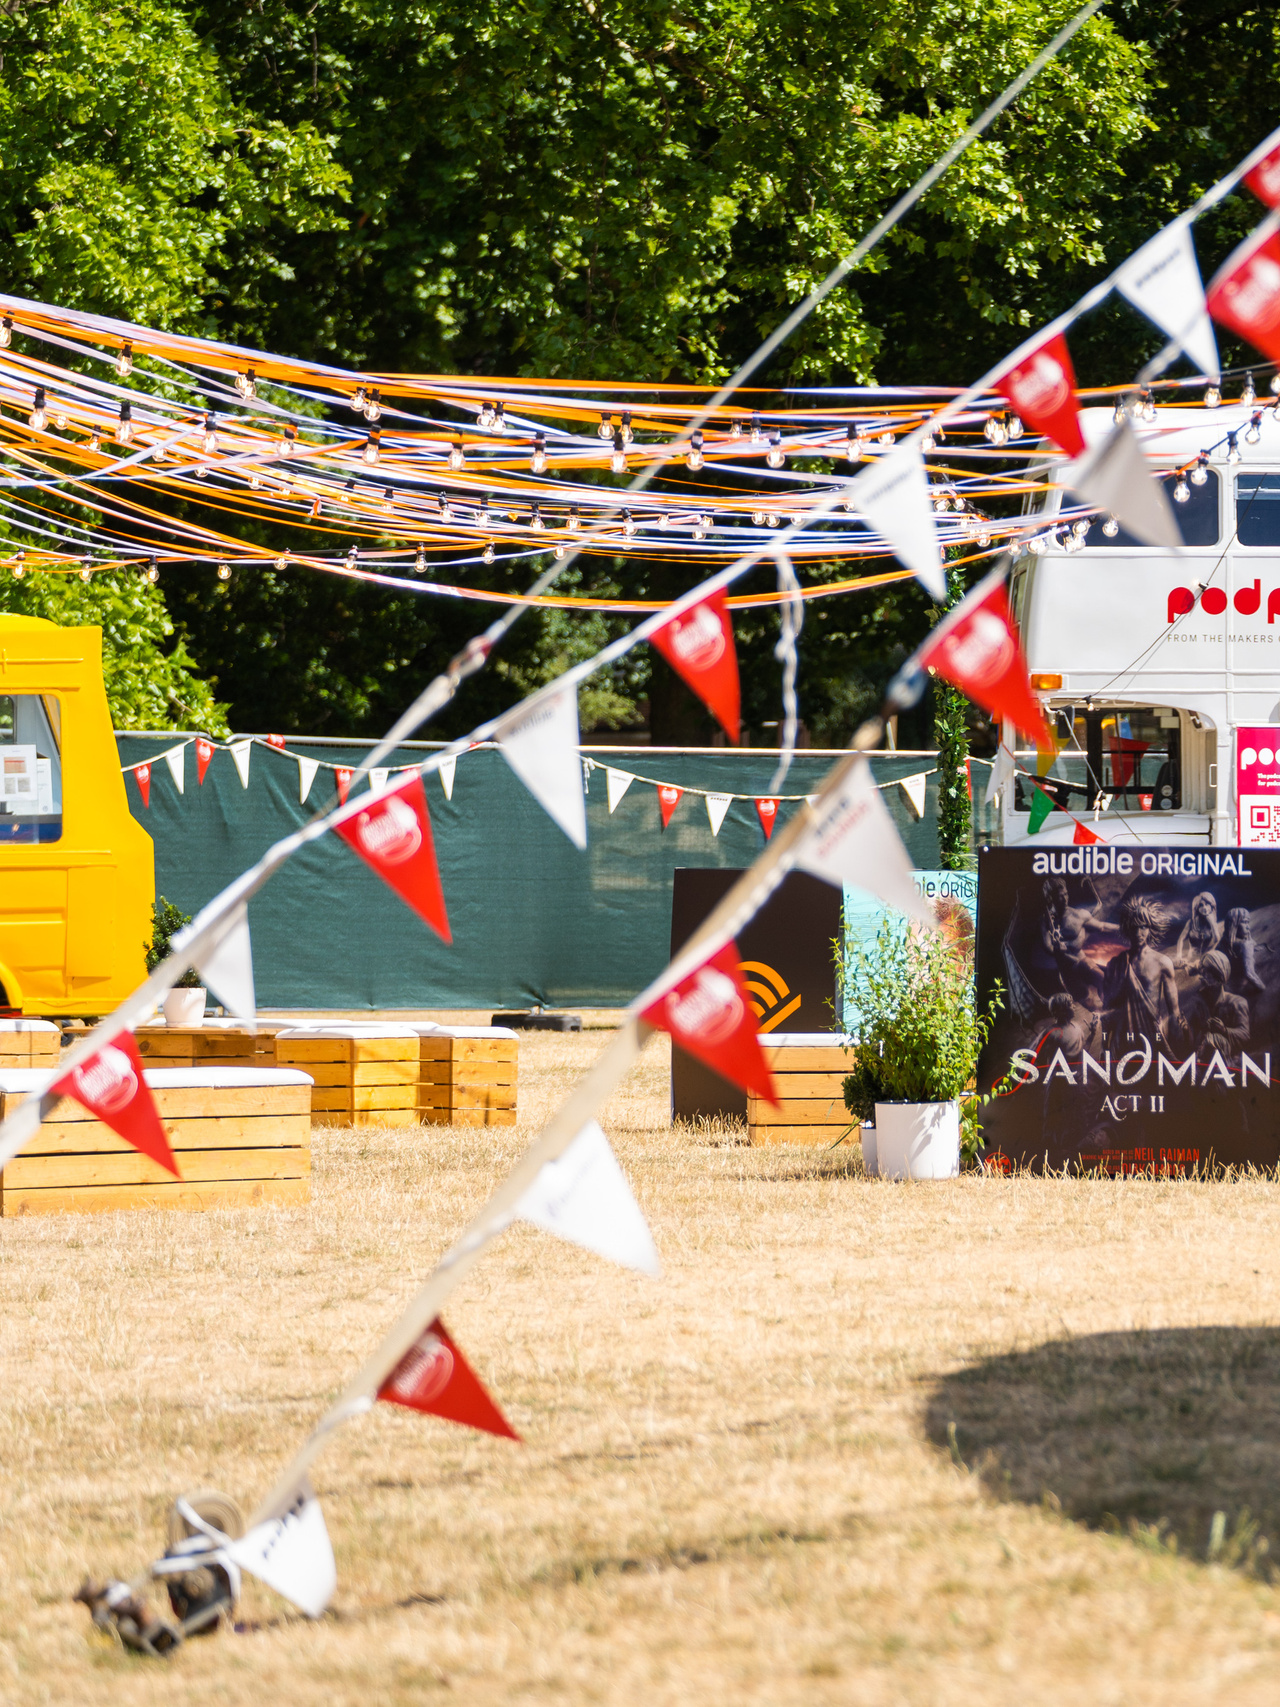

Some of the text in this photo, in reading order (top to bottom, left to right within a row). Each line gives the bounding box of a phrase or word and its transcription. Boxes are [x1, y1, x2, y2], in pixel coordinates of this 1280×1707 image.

[1167, 634, 1197, 643] FROM
[1203, 634, 1223, 643] THE
[1228, 634, 1274, 643] MAKERS
[1032, 846, 1252, 876] audible ORIGINAL
[1102, 1032, 1162, 1042] THE
[1010, 1033, 1272, 1089] SANDMAN
[1100, 1094, 1165, 1122] ACT II
[1134, 1147, 1156, 1161] NEIL
[1159, 1147, 1200, 1162] GAIMAN
